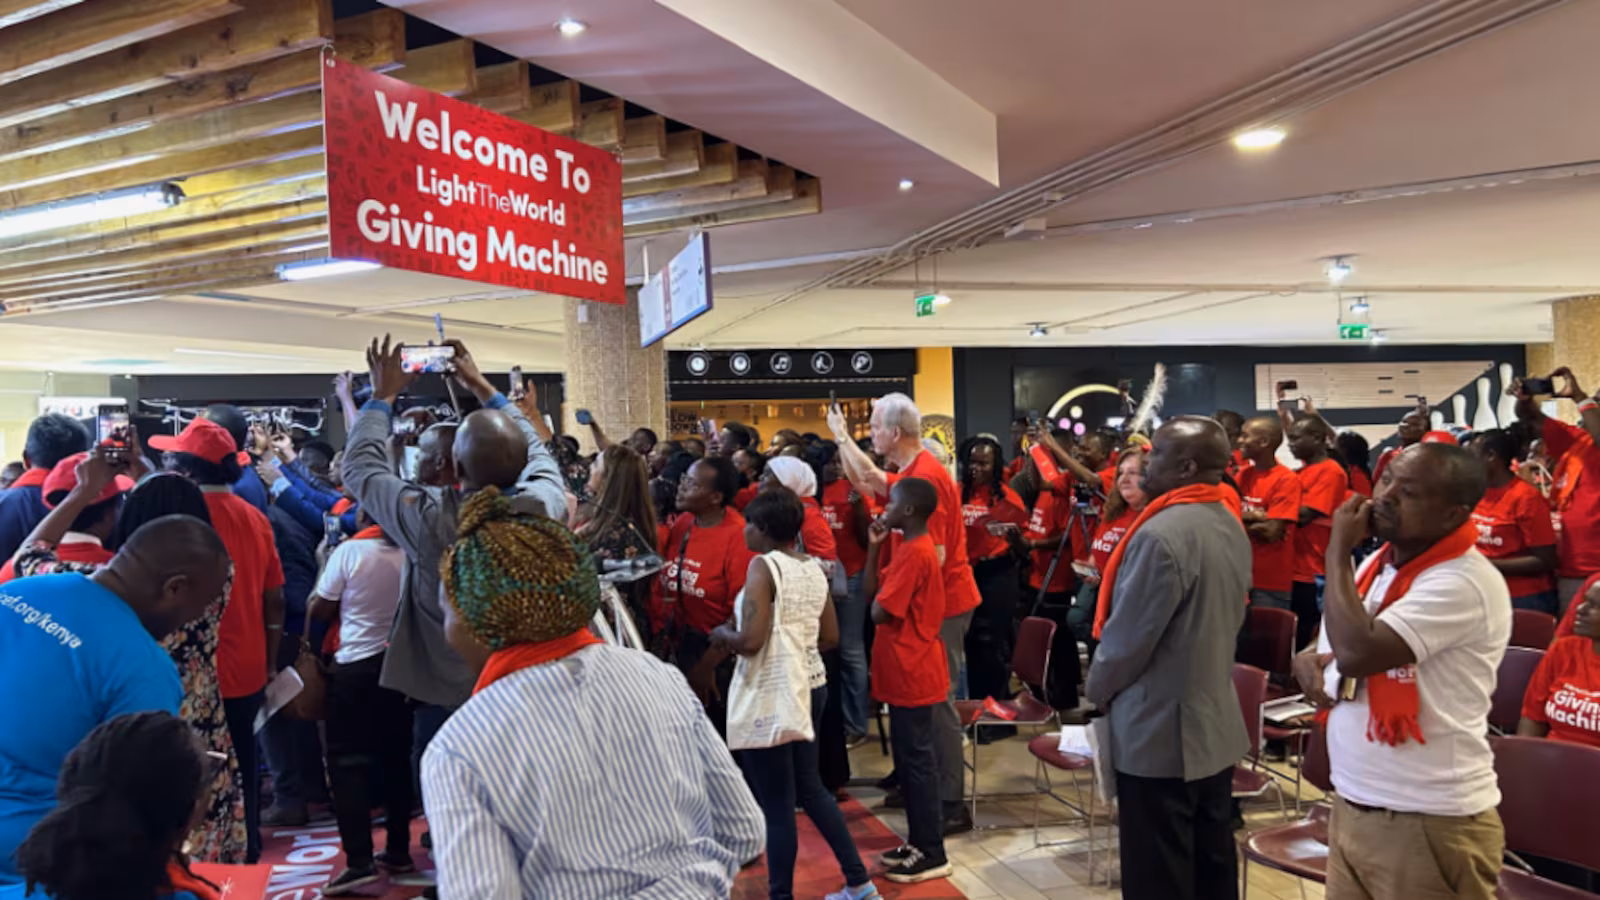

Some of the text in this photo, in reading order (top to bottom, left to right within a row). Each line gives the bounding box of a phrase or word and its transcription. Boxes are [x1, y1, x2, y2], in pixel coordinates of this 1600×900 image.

[375, 90, 591, 194] Welcome To
[416, 164, 566, 227] LightTheWorld
[357, 199, 608, 285] Giving Machine
[1545, 700, 1600, 732] Machi
[1554, 690, 1600, 714] Givin
